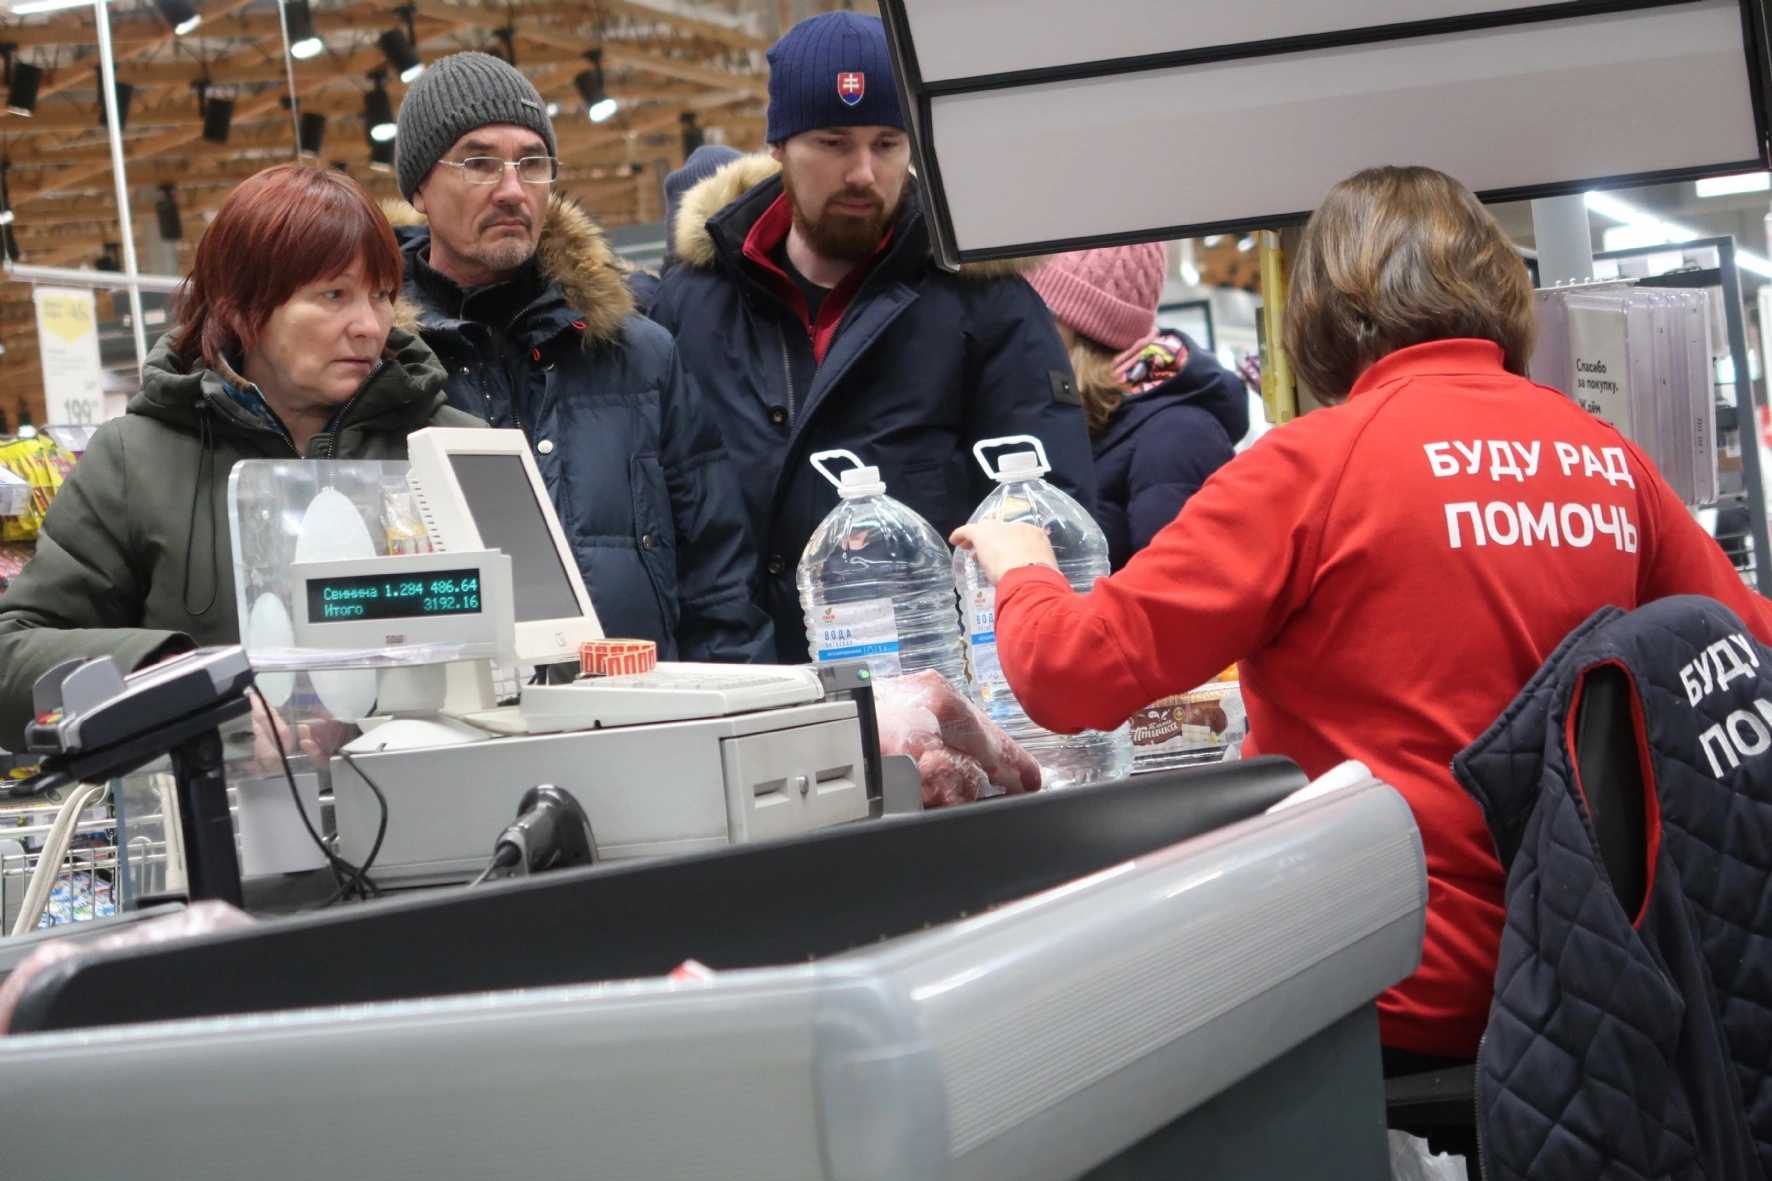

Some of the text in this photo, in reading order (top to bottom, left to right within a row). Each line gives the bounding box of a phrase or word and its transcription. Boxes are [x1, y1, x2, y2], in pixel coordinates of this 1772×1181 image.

[1576, 358, 1607, 374] Спасибо
[1577, 378, 1619, 395] за покупку.
[1423, 439, 1636, 489] БУДУ РАД
[1444, 501, 1638, 554] ПОМОЧЬ
[323, 578, 478, 601] Свинина 1.284 486.64
[324, 595, 479, 618] Итого 3192.16
[976, 612, 994, 625] ВОД
[824, 628, 852, 641] ВОДА
[1679, 633, 1760, 708] БУДУ
[1131, 721, 1179, 742] Птичка
